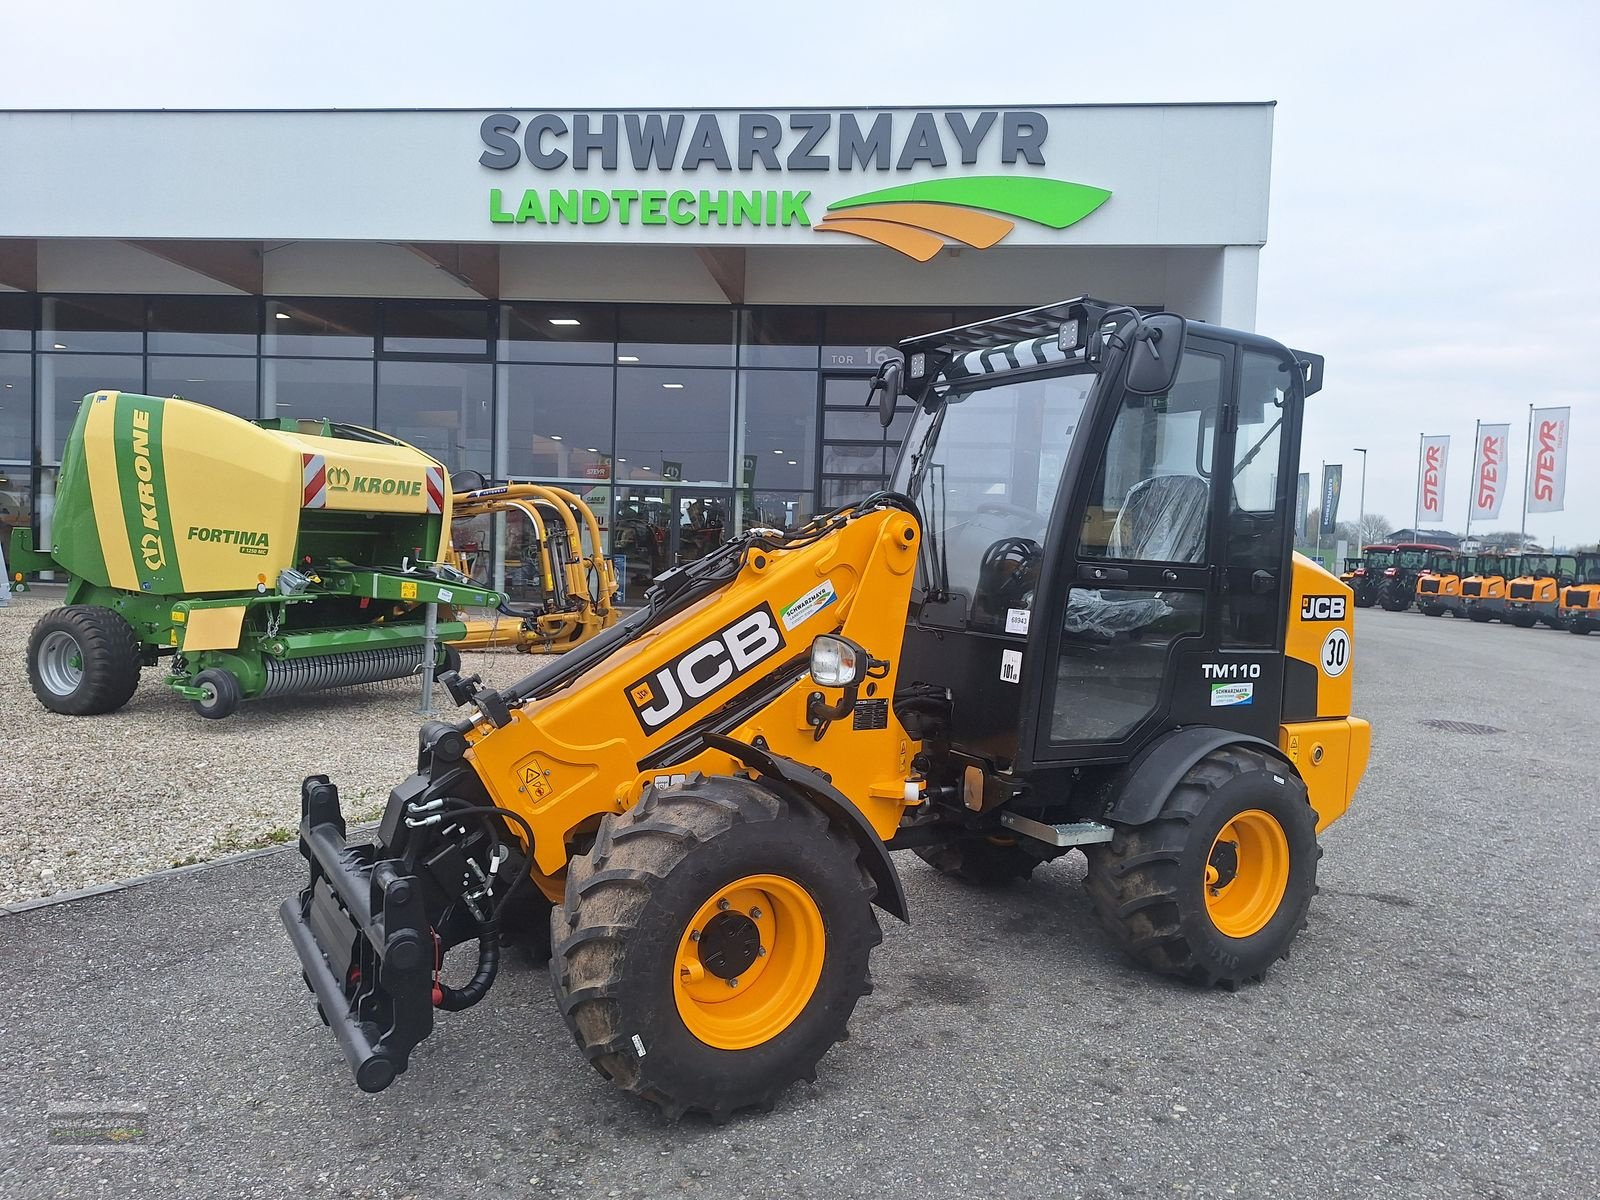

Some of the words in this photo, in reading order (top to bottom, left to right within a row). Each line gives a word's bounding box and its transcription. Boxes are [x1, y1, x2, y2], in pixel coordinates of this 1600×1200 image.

[478, 111, 1049, 172] SCHWARZMAYR
[490, 188, 811, 227] LANDTECHNIK
[831, 355, 854, 364] TOR
[865, 347, 889, 364] 16
[132, 409, 160, 531] KRONE
[1477, 435, 1499, 511] STEYR
[1534, 420, 1558, 502] STEYR
[352, 476, 422, 497] KRONE
[1423, 445, 1441, 513] STEYR
[1323, 478, 1333, 526] SCHWARZMAYR
[187, 526, 269, 547] FORTIMA
[786, 588, 827, 617] SCHWARZMAYR
[1302, 597, 1345, 619] JCB
[641, 611, 780, 726] JCB
[1326, 638, 1345, 666] 30
[1003, 664, 1014, 679] 101
[1201, 663, 1261, 678] TM110
